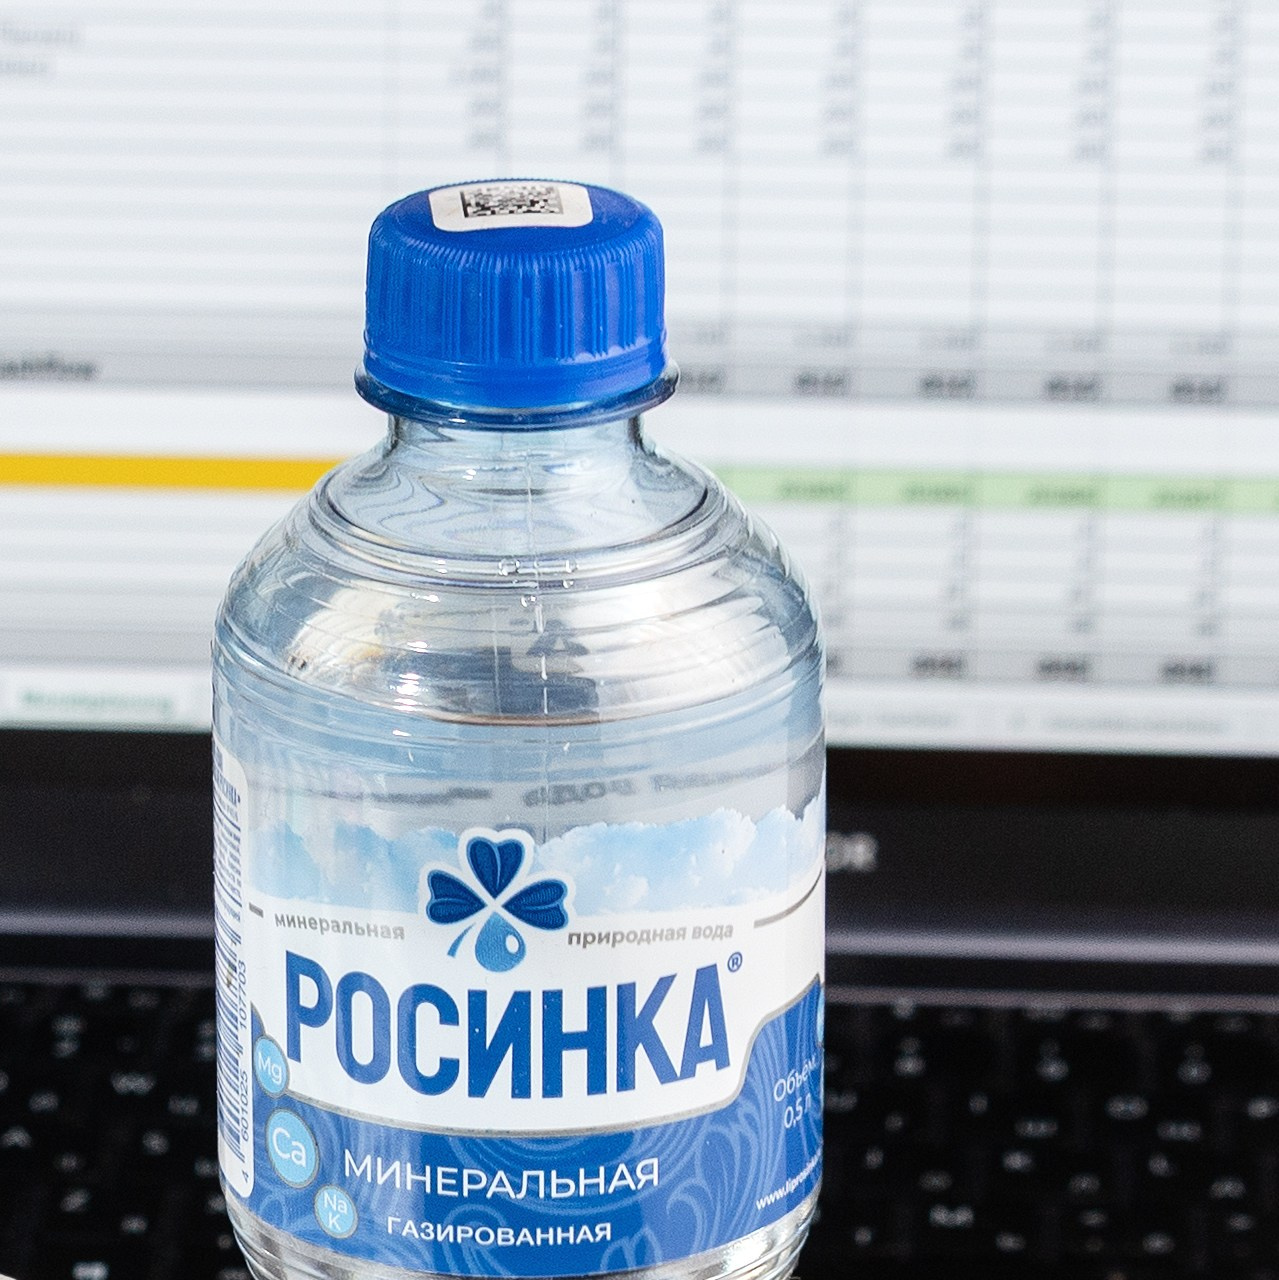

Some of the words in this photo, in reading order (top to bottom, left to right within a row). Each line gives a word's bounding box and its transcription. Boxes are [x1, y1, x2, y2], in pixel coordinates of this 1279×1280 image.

[274, 911, 405, 941] минеральная
[567, 924, 686, 949] природная
[691, 921, 734, 942] вода
[238, 961, 247, 1030] 107703
[258, 1051, 282, 1084] Mg
[239, 1070, 249, 1142] 601025
[783, 1100, 803, 1129] 0,5
[272, 1126, 307, 1168] Ca
[242, 1171, 249, 1184] 4
[344, 1148, 659, 1200] МИНЕРАЛЬНАЯ
[323, 1191, 348, 1214] Na
[327, 1213, 341, 1231] K
[386, 1215, 612, 1246] ГАЗИРОВАННАЯ
